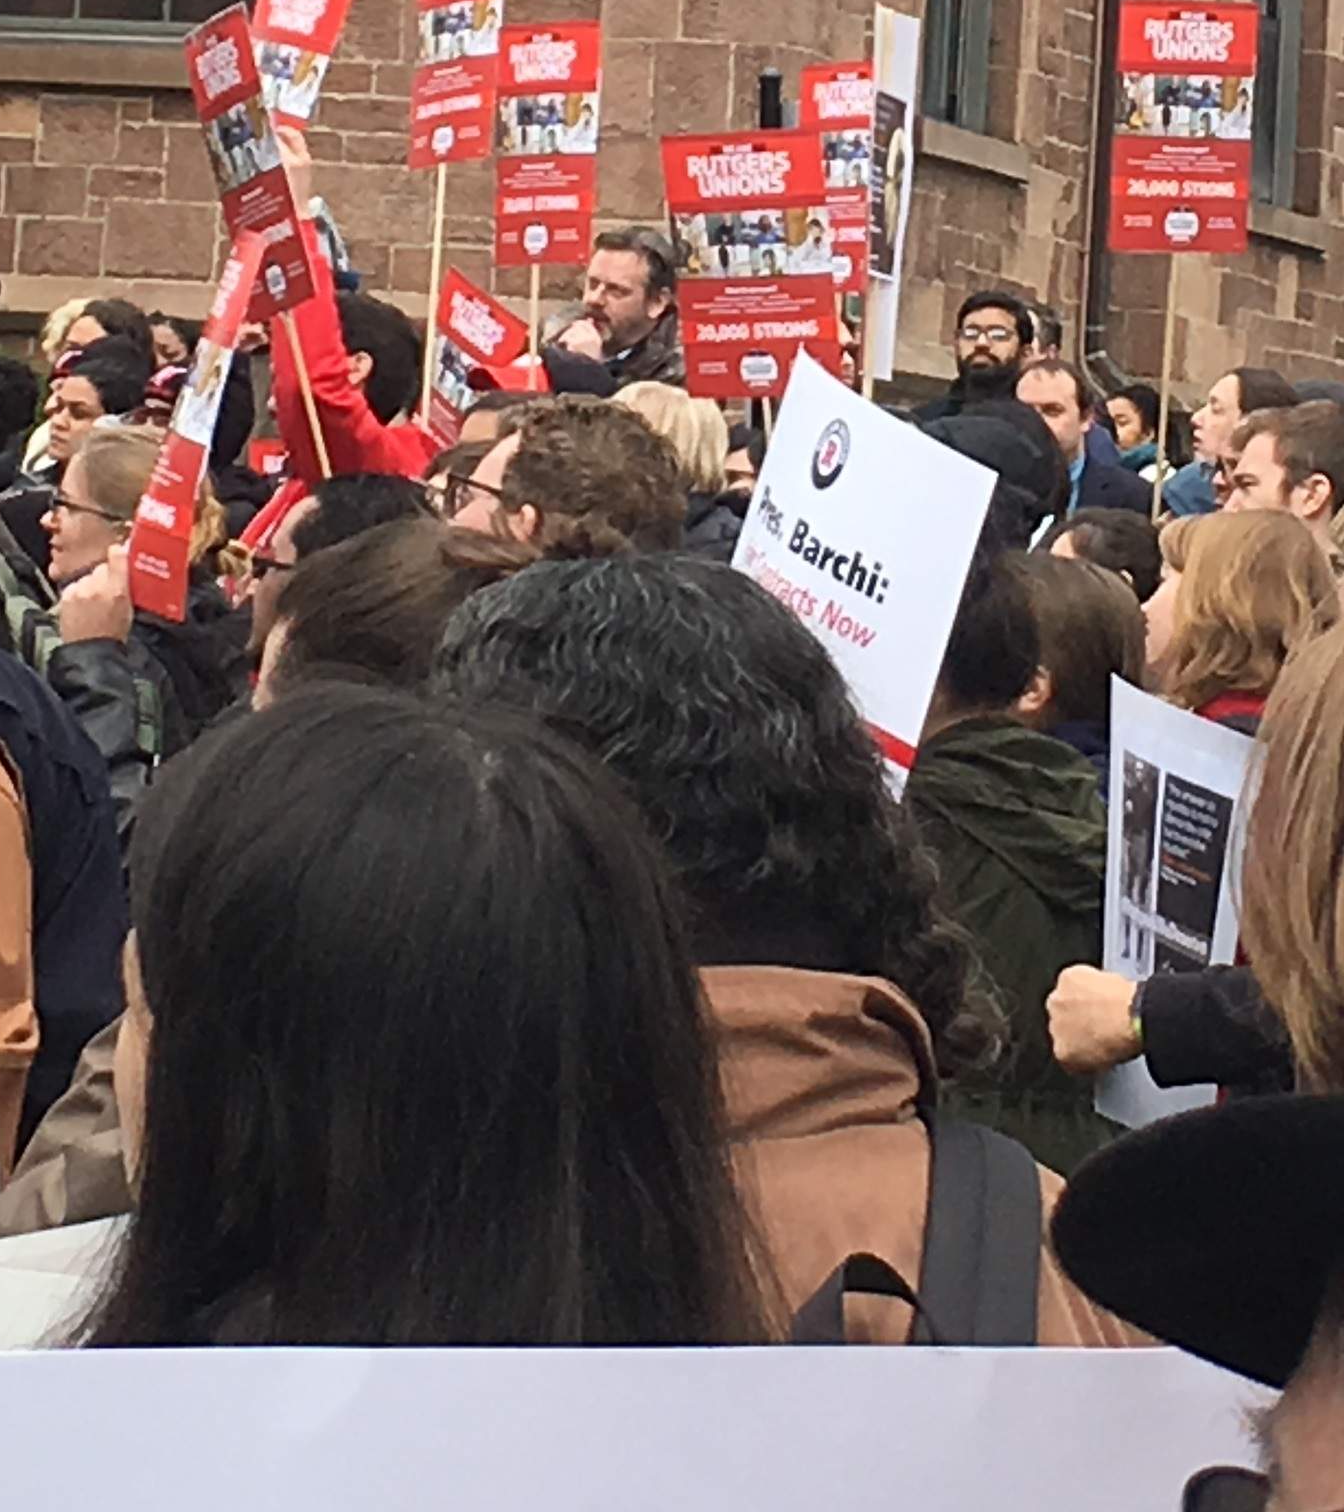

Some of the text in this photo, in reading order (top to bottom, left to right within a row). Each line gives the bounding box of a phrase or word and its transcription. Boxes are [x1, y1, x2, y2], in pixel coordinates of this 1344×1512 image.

[1144, 18, 1234, 45] RUTGERS
[1152, 38, 1229, 62] UNIONS
[686, 151, 791, 178] RUTGERS
[698, 173, 786, 198] UNIONS
[788, 518, 890, 605] Barchi:
[819, 599, 877, 648] Now
